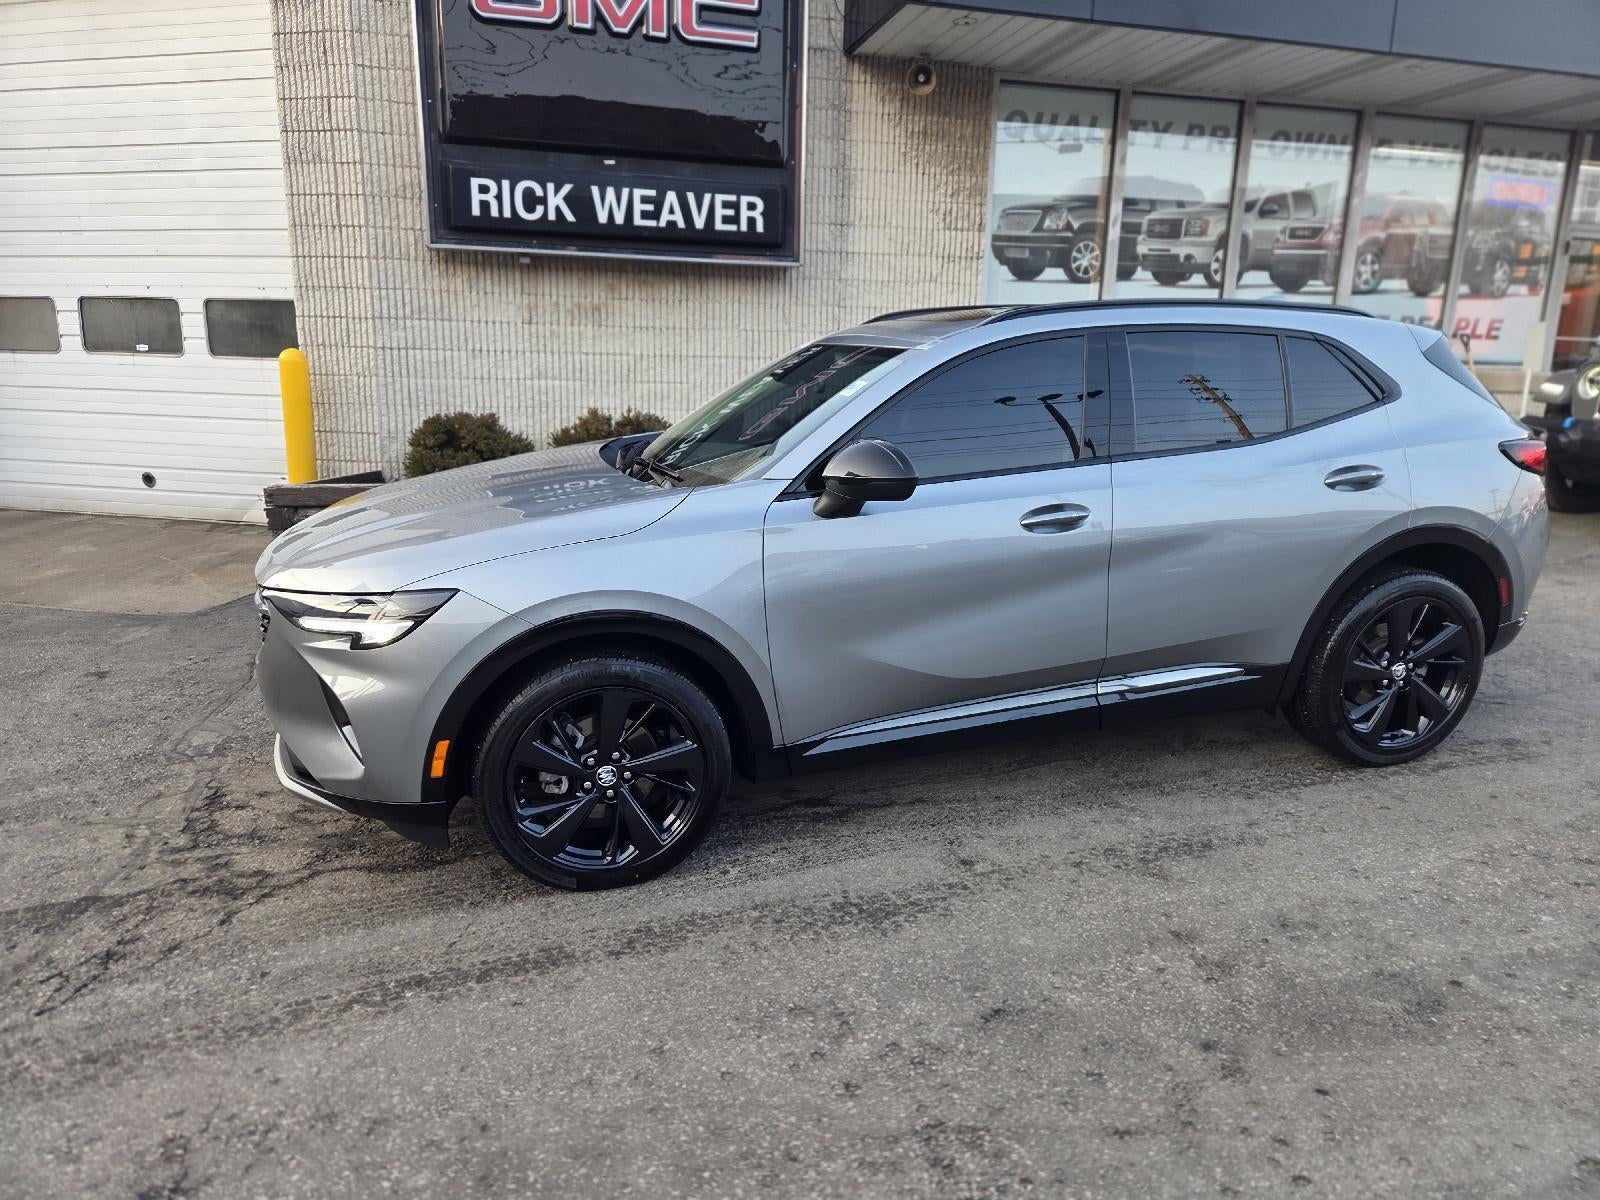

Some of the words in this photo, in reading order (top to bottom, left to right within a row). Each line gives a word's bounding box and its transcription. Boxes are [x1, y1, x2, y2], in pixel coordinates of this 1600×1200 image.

[1003, 110, 1175, 148] QUALTY
[469, 177, 577, 223] RICK
[590, 185, 765, 233] WEAVER
